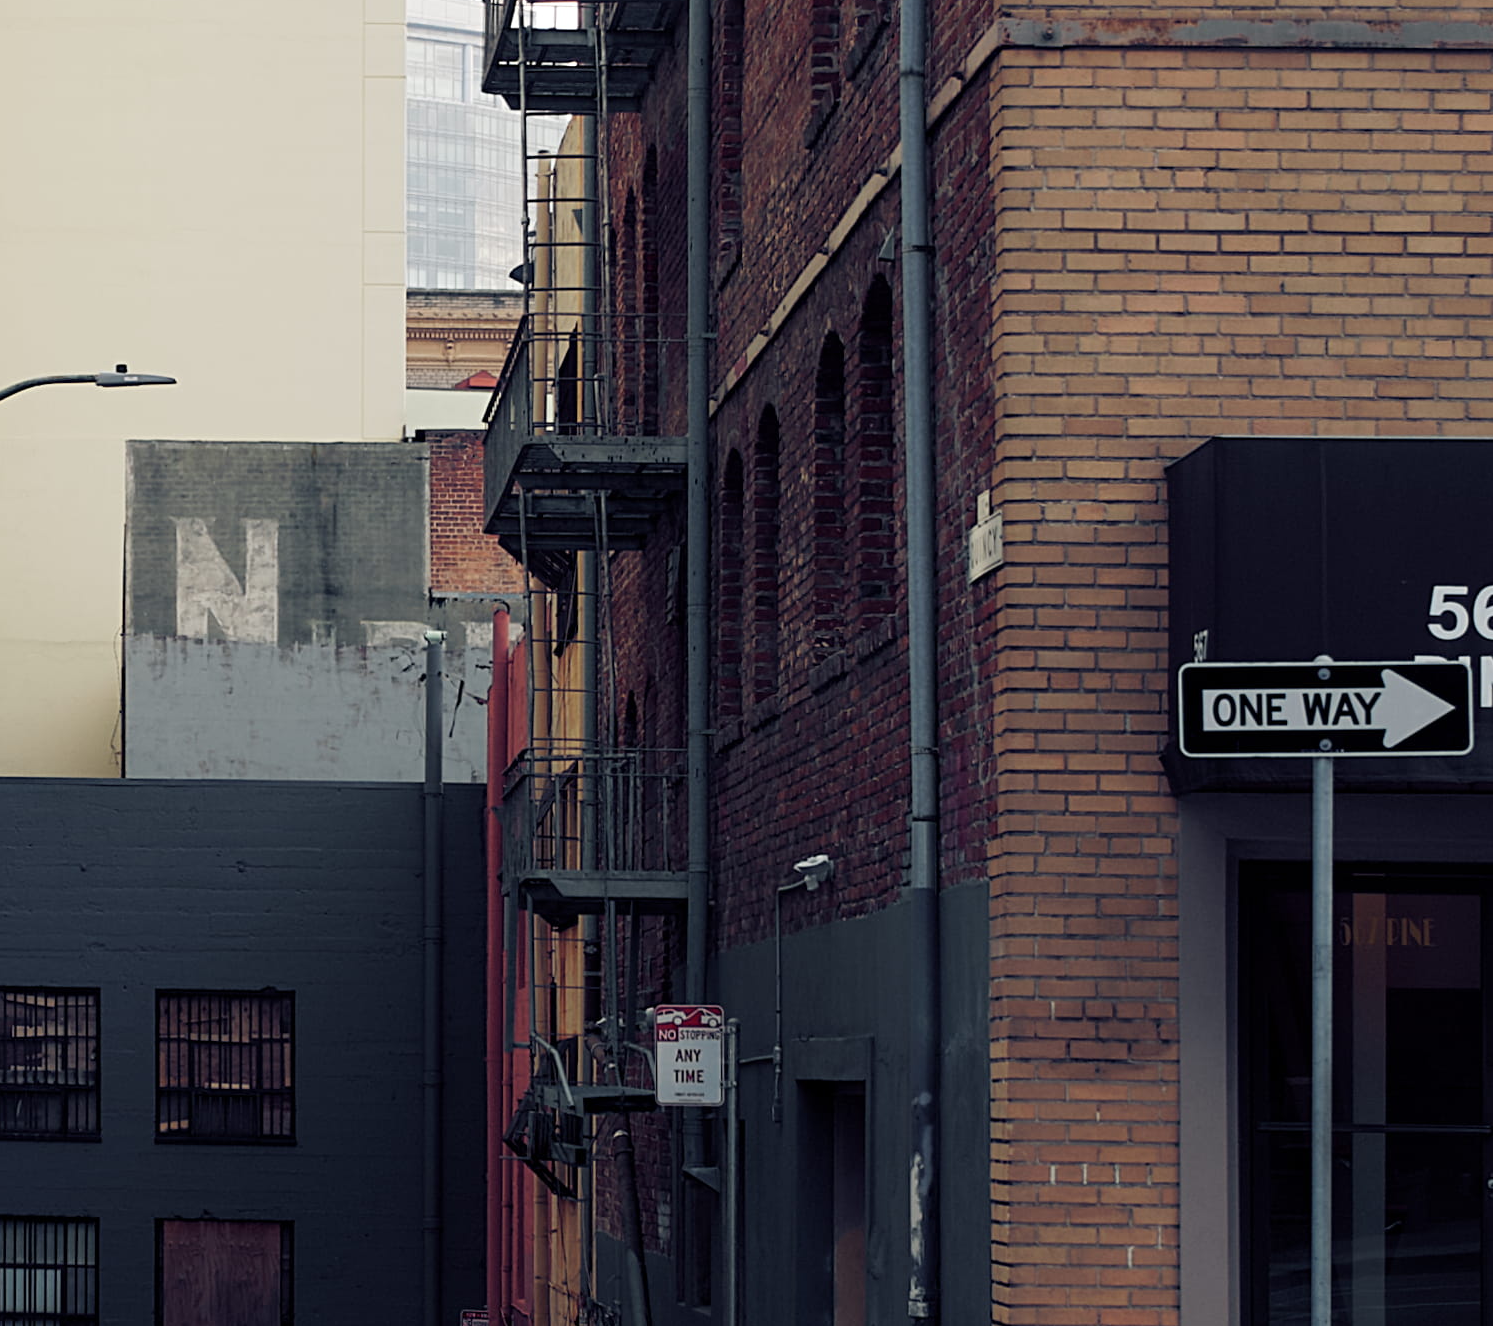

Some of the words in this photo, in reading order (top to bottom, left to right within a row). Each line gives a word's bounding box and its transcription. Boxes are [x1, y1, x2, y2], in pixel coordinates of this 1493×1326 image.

[1213, 693, 1287, 727] ONE
[1302, 692, 1382, 725] WAY
[1386, 916, 1439, 947] PINE
[658, 1029, 677, 1041] NO
[679, 1030, 721, 1041] STOPPING
[675, 1049, 702, 1063] ANY
[673, 1069, 704, 1084] TIME
